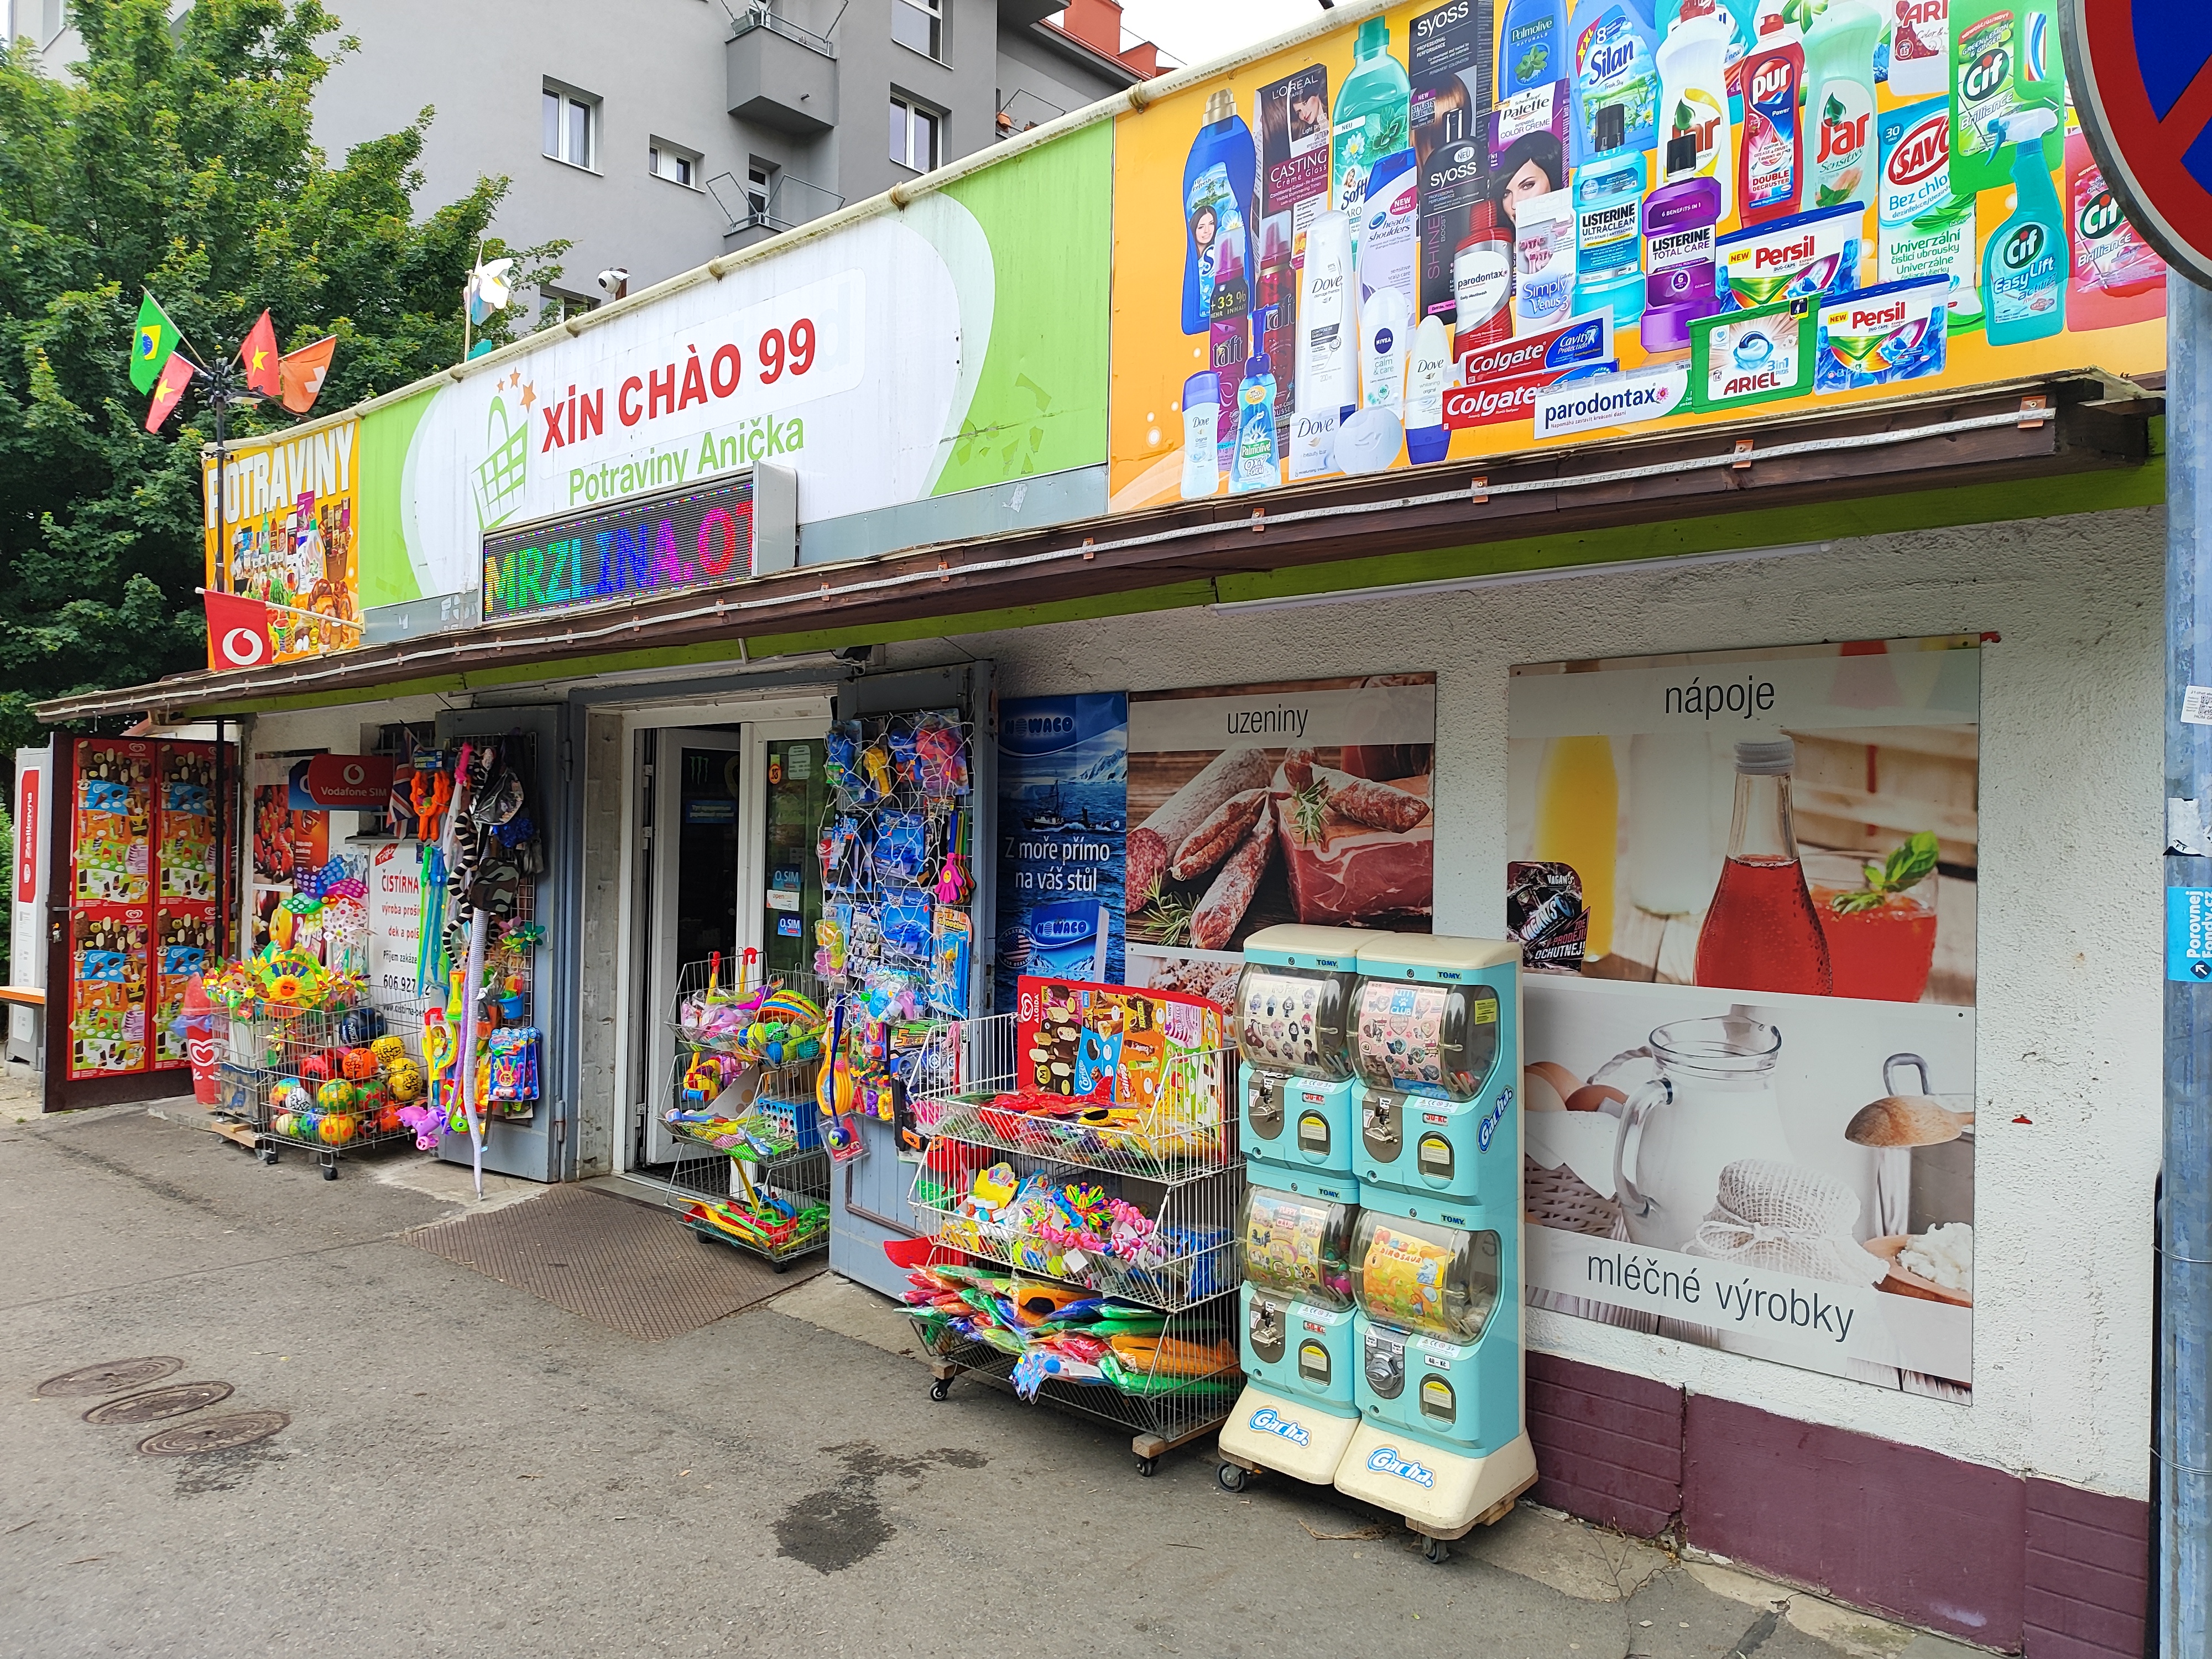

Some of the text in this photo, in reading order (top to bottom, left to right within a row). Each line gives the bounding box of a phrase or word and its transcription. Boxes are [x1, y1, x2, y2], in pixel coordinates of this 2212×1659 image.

[1511, 19, 1552, 42] Palmolive
[1516, 32, 1548, 47] NATURALS
[1596, 27, 1607, 44] 8
[1916, 28, 1936, 39] Color
[1962, 23, 2009, 55] GREEN LEMON
[1416, 36, 1446, 52] PROFESSIONAL
[1416, 42, 1446, 58] PERFORMANCE
[1976, 34, 2002, 53] GINGER
[1589, 40, 1634, 85] Silan
[1966, 53, 2003, 97] Cif
[1418, 92, 1429, 101] NEW
[1412, 106, 1434, 119] SELECTION
[1503, 97, 1550, 120] Palette
[1772, 107, 1790, 117] Power
[1960, 92, 2013, 131] Brilliance
[1342, 122, 1353, 131] NEU
[1501, 119, 1550, 139] COLOR CREME
[1885, 126, 1900, 139] 30
[1458, 150, 1470, 160] NEU
[1270, 149, 1327, 182] CASTING
[1276, 164, 1327, 188] Crème Gloss
[1752, 169, 1790, 185] DOUBLE
[1752, 178, 1790, 191] DECRUSTER
[1428, 189, 1454, 199] PROFESSIONAL
[1428, 194, 1455, 204] PERFORMANCE
[1889, 171, 1949, 211] Bez chlo
[1391, 204, 1411, 213] FORMULA
[1394, 195, 1411, 207] NEW
[1583, 202, 1635, 228] LISTERINE
[1666, 205, 1691, 217] BENEFITS
[1368, 225, 1410, 242] shoulders
[1582, 216, 1635, 236] ULTRACLEAN
[1427, 216, 1441, 279] SHINE
[1653, 228, 1710, 252] LISTERINE
[1891, 228, 1960, 255] Univerzální
[2006, 227, 2037, 264] Cif
[1653, 241, 1710, 260] TOTAL CARE
[1730, 235, 1814, 269] NEW Persil
[1917, 242, 1960, 259] ubrousky
[2077, 232, 2132, 268] Brilliance
[1897, 255, 1954, 275] Univerzálne
[1926, 266, 1949, 277] utierky
[2030, 256, 2054, 278] Lift
[1458, 269, 1503, 290] parodontax
[1524, 277, 1567, 300] Simply
[1994, 271, 2029, 294] Easy
[1529, 298, 1560, 314] Venus
[1830, 301, 1906, 329] NEW Persil
[1558, 342, 1588, 355] Protection
[1560, 331, 1589, 349] Cavity
[1213, 335, 1243, 368] taft
[1469, 343, 1544, 374] Colgate
[618, 344, 741, 426] CHÀO
[759, 319, 815, 384] 99
[1375, 358, 1393, 368] calm
[1380, 365, 1394, 374] care
[1767, 358, 1789, 371] 3in1
[1724, 372, 1780, 395] ARIEL
[1447, 387, 1536, 418] Colgate
[1545, 388, 1655, 429] parodontax
[1241, 442, 1271, 456] Palmolive
[1303, 450, 1318, 458] beauty
[569, 415, 804, 505] Potraviny Anička
[1245, 457, 1266, 470] OXY
[207, 422, 354, 529] POTRAVINY
[1666, 675, 1774, 720] nápoje
[1227, 703, 1308, 738] uzeniny
[321, 787, 387, 796] Vodafone SIM
[1005, 836, 1110, 865] Z moře přímo
[382, 869, 419, 894] ČISTÍRNA
[784, 871, 799, 883] SIM
[1016, 866, 1098, 893] na váš stůl
[382, 902, 401, 914] výroba
[388, 926, 404, 937] dek a
[787, 919, 800, 928] SIM
[1005, 929, 1026, 937] ALASKA
[2187, 891, 2203, 957] Porovnej
[383, 950, 398, 962] Příjem
[383, 974, 416, 993] 606 927
[1395, 989, 1415, 997] KITTY
[1279, 1206, 1298, 1215] PUPPY
[1277, 1219, 1294, 1228] CLUB
[1380, 1248, 1421, 1263] DINOSAUR
[1588, 1254, 1854, 1343] mléčné výrobky
